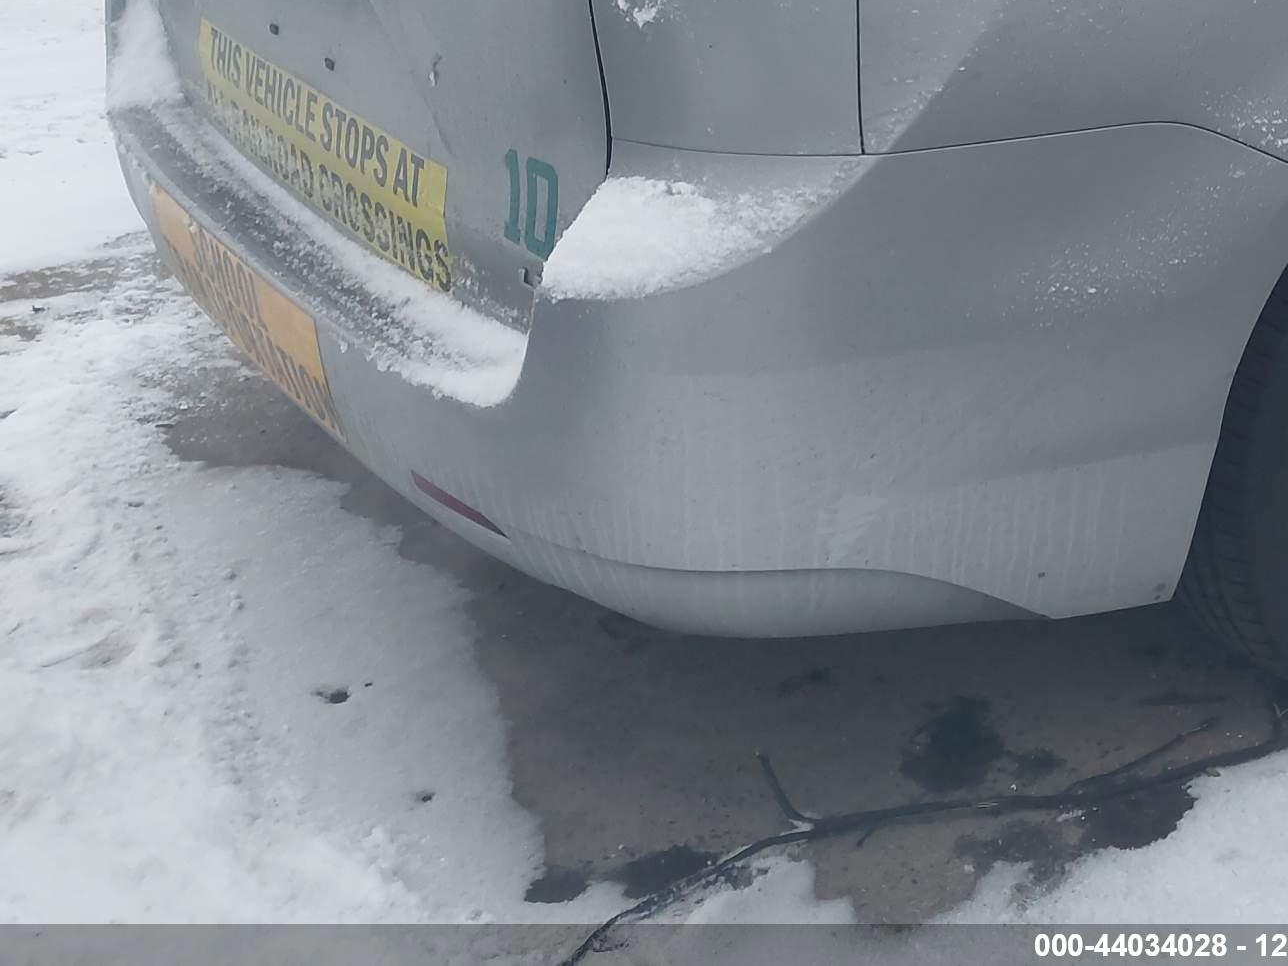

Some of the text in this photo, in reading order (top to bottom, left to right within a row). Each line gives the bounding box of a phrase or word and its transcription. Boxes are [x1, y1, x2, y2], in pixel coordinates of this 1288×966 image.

[210, 27, 242, 88] THIS
[246, 50, 318, 142] VEHICLE
[320, 102, 389, 187] STOPS
[393, 148, 424, 207] AT
[319, 164, 451, 292] CROSSINGS
[504, 148, 559, 262] 10
